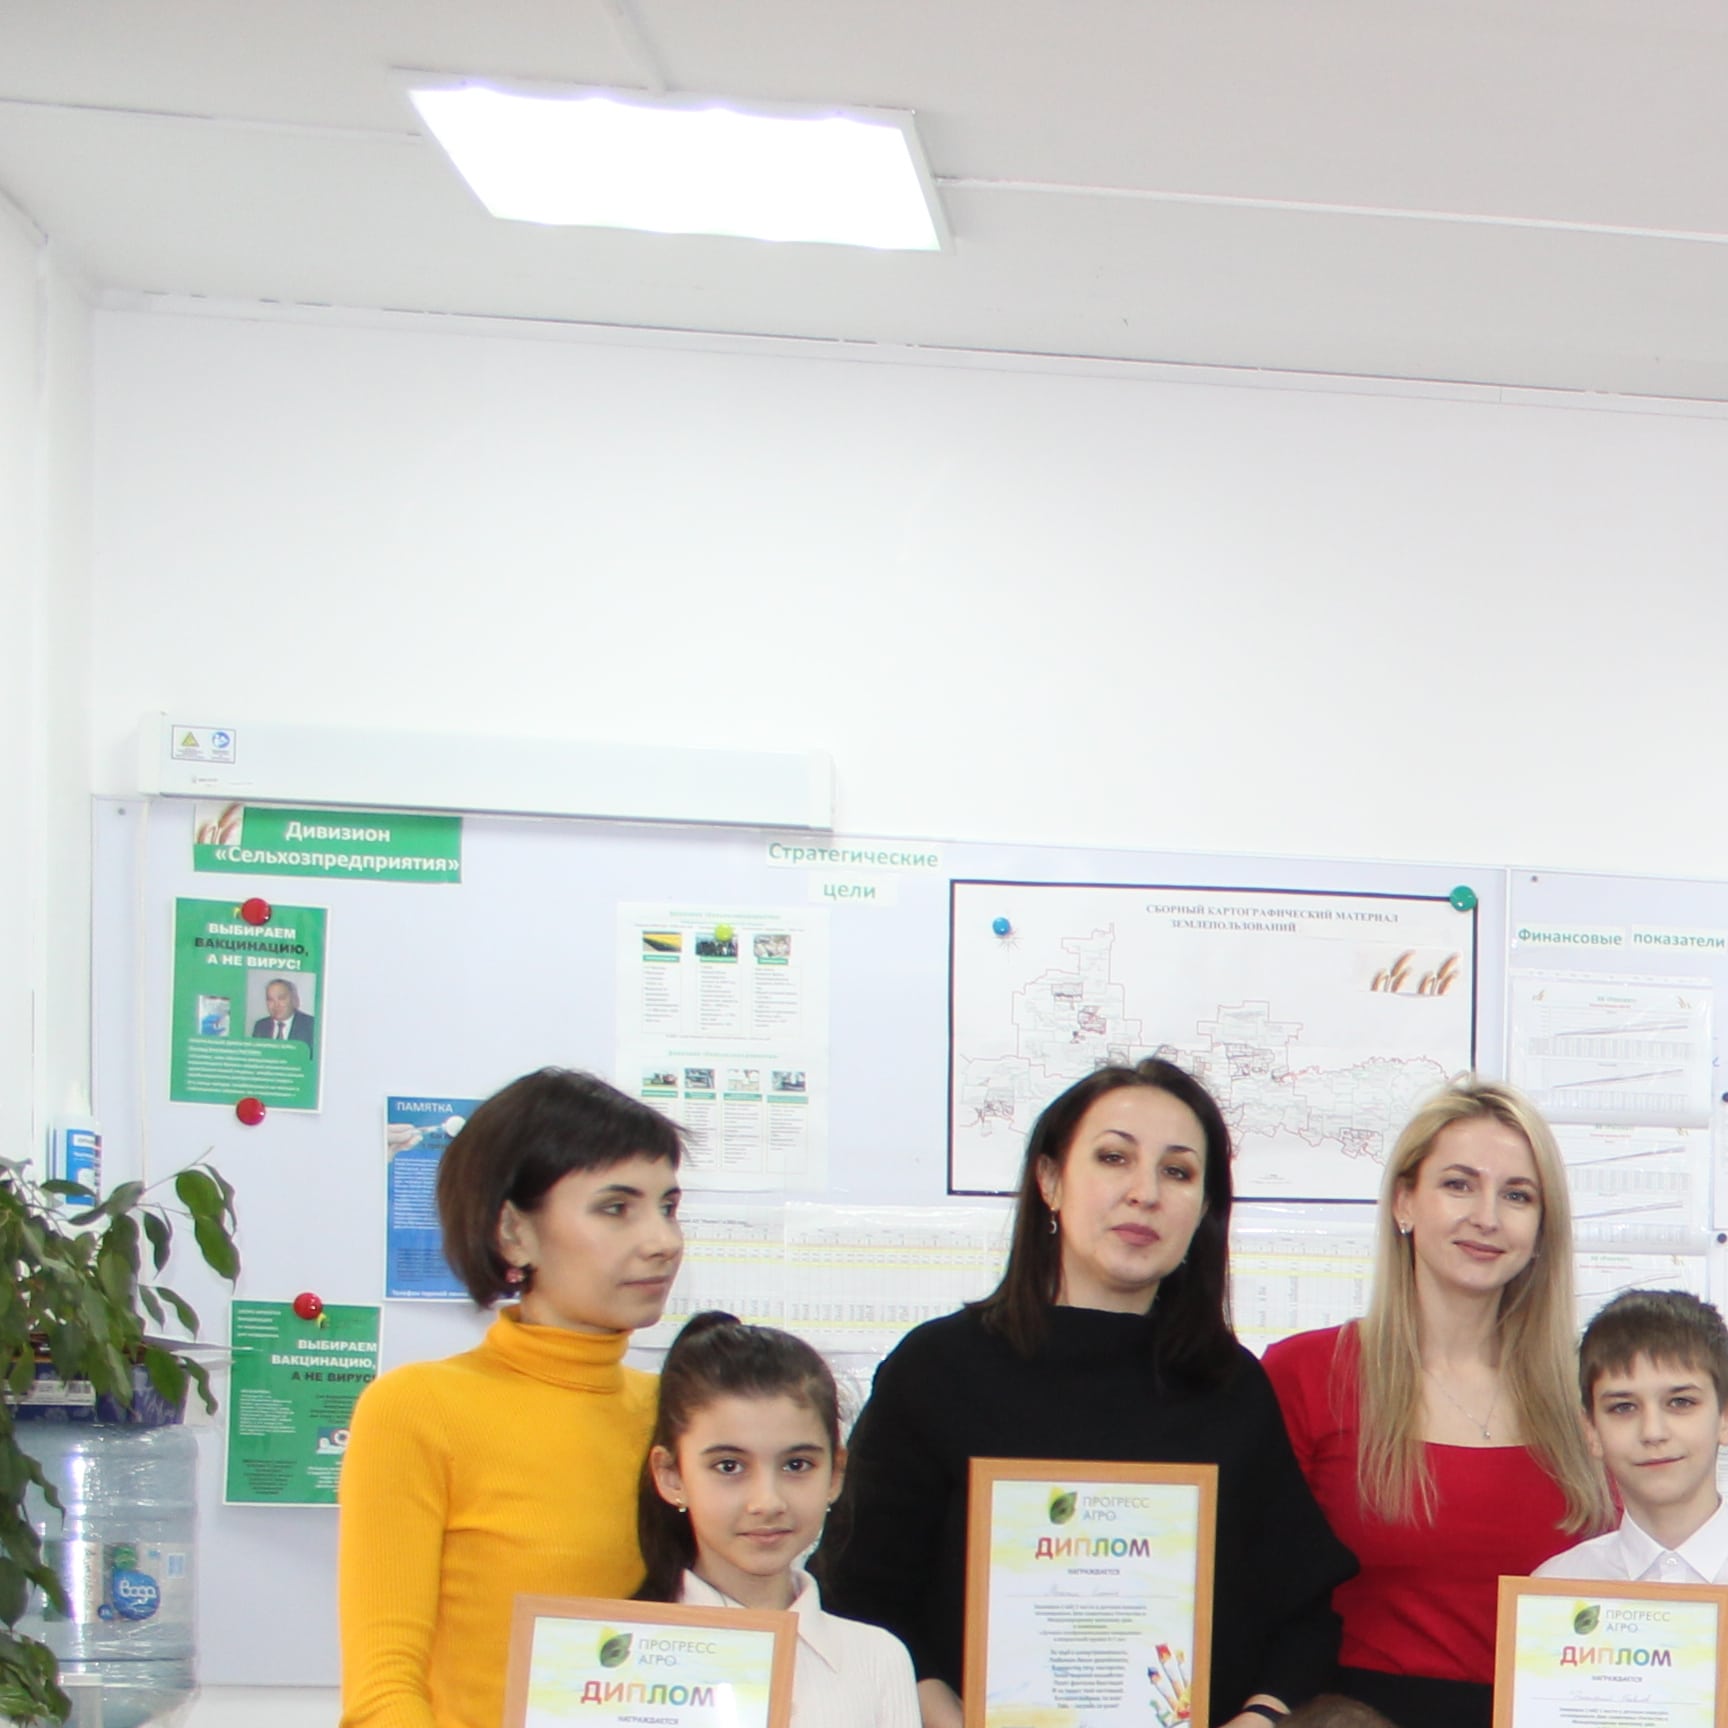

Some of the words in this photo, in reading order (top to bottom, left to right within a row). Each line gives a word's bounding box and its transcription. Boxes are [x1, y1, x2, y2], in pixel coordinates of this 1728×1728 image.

[284, 821, 391, 842] Дивизион
[214, 846, 460, 873] «Сельхозпредприятия»
[768, 842, 939, 868] Стратегические
[823, 884, 876, 901] цели
[1207, 905, 1333, 921] КАРТОГРАФИЧЕСКИЙ
[1335, 911, 1399, 923] МАТЕРИАЛ
[208, 923, 296, 939] ВЫБИРАЕМ
[1517, 927, 1623, 947] Финансовые
[1633, 931, 1726, 950] показатели
[194, 937, 309, 956] ВАКЦИНАЦИЮ,
[207, 954, 218, 966] А
[221, 955, 242, 967] НЕ
[246, 956, 301, 970] ВИРУС!
[396, 1101, 454, 1114] ПАМЯТКА
[297, 1338, 378, 1353] ВЫБИРАЕМ
[271, 1353, 377, 1370] ВАКЦИНАЦИЮ,
[291, 1372, 301, 1382] А
[304, 1372, 323, 1382] НЕ
[1082, 1495, 1150, 1509] ПРОГРЕСС
[1082, 1510, 1117, 1523] АГРО
[1035, 1537, 1151, 1561] ДИПЛОМ
[1605, 1609, 1671, 1623] ПРОГРЕСС
[1605, 1623, 1639, 1634] АГРО
[638, 1638, 717, 1655] ПРОГРЕСС
[638, 1654, 678, 1667] АГРО
[1560, 1645, 1672, 1668] ДИПЛОМ
[580, 1679, 716, 1708] ДИПЛОМ
